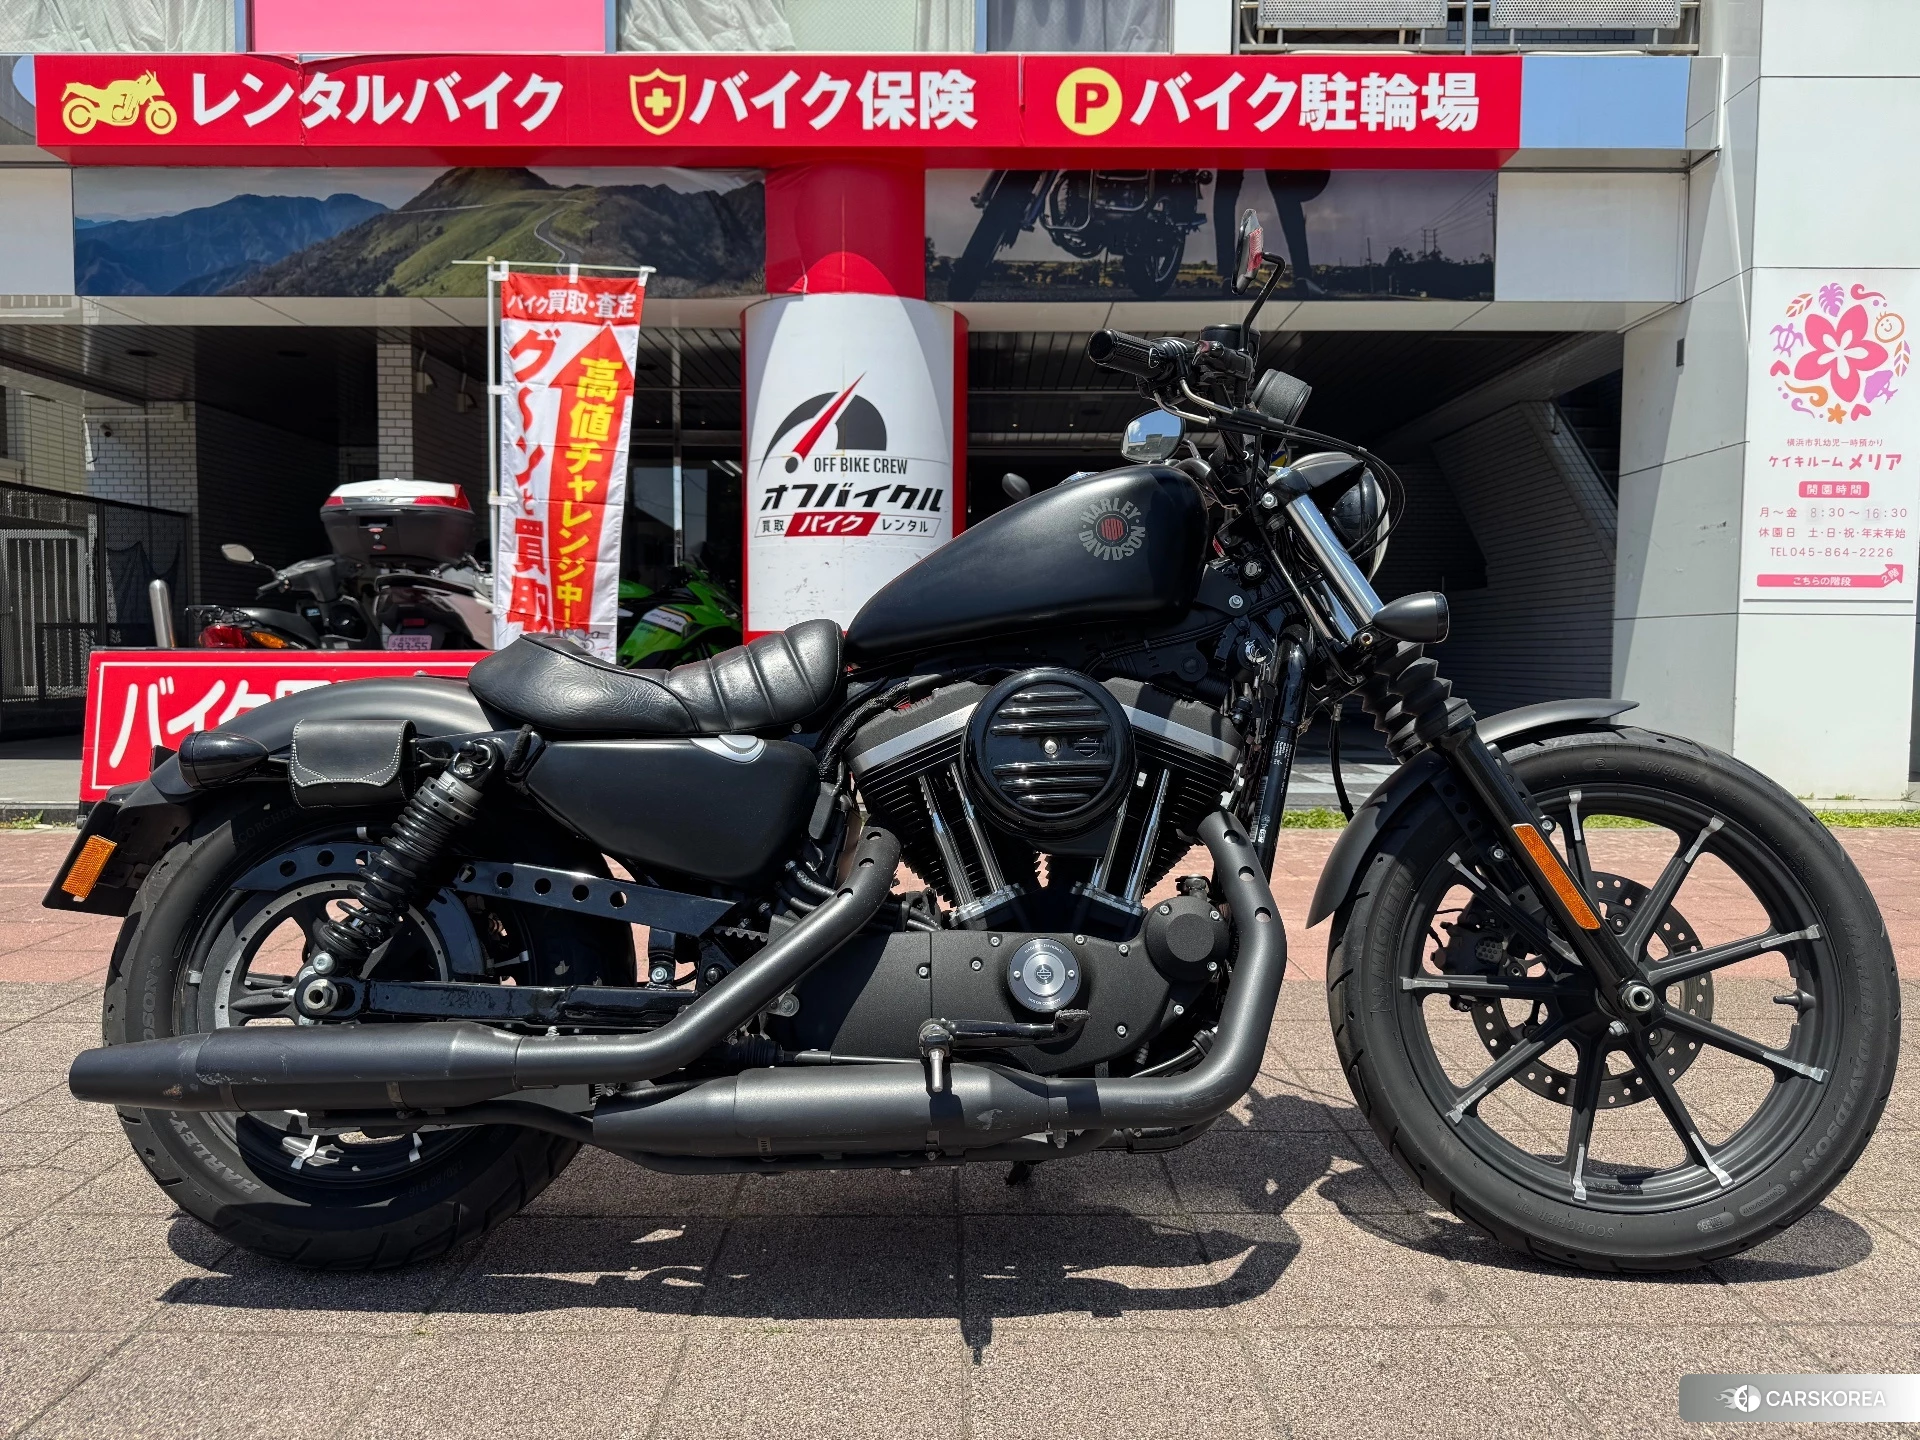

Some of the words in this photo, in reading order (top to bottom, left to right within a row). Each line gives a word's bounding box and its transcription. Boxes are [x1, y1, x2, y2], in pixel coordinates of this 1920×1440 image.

[193, 71, 564, 132] レンタルバイク
[689, 69, 978, 131] バイク保険
[1075, 82, 1110, 124] P
[1130, 71, 1480, 132] バイク駐輪場
[507, 289, 636, 318] バイク買取・査定
[1786, 438, 1884, 447] 横浜市乳幼児一時預かり
[814, 457, 836, 473] OFF
[840, 457, 870, 473] BIKE
[873, 458, 908, 475] CREW
[1768, 455, 1844, 468] ケイキルーム
[1848, 453, 1902, 471] メリア
[760, 482, 944, 512] オフバイクル
[1806, 484, 1862, 496] 開園時間
[1080, 497, 1142, 525] HARLEY
[762, 519, 785, 533] 買取
[798, 515, 865, 533] バイク
[882, 518, 929, 533] レンタル
[1758, 527, 1796, 539] 休園日
[1078, 525, 1146, 561] DAVIDSON
[1793, 576, 1852, 587] こちらの階段
